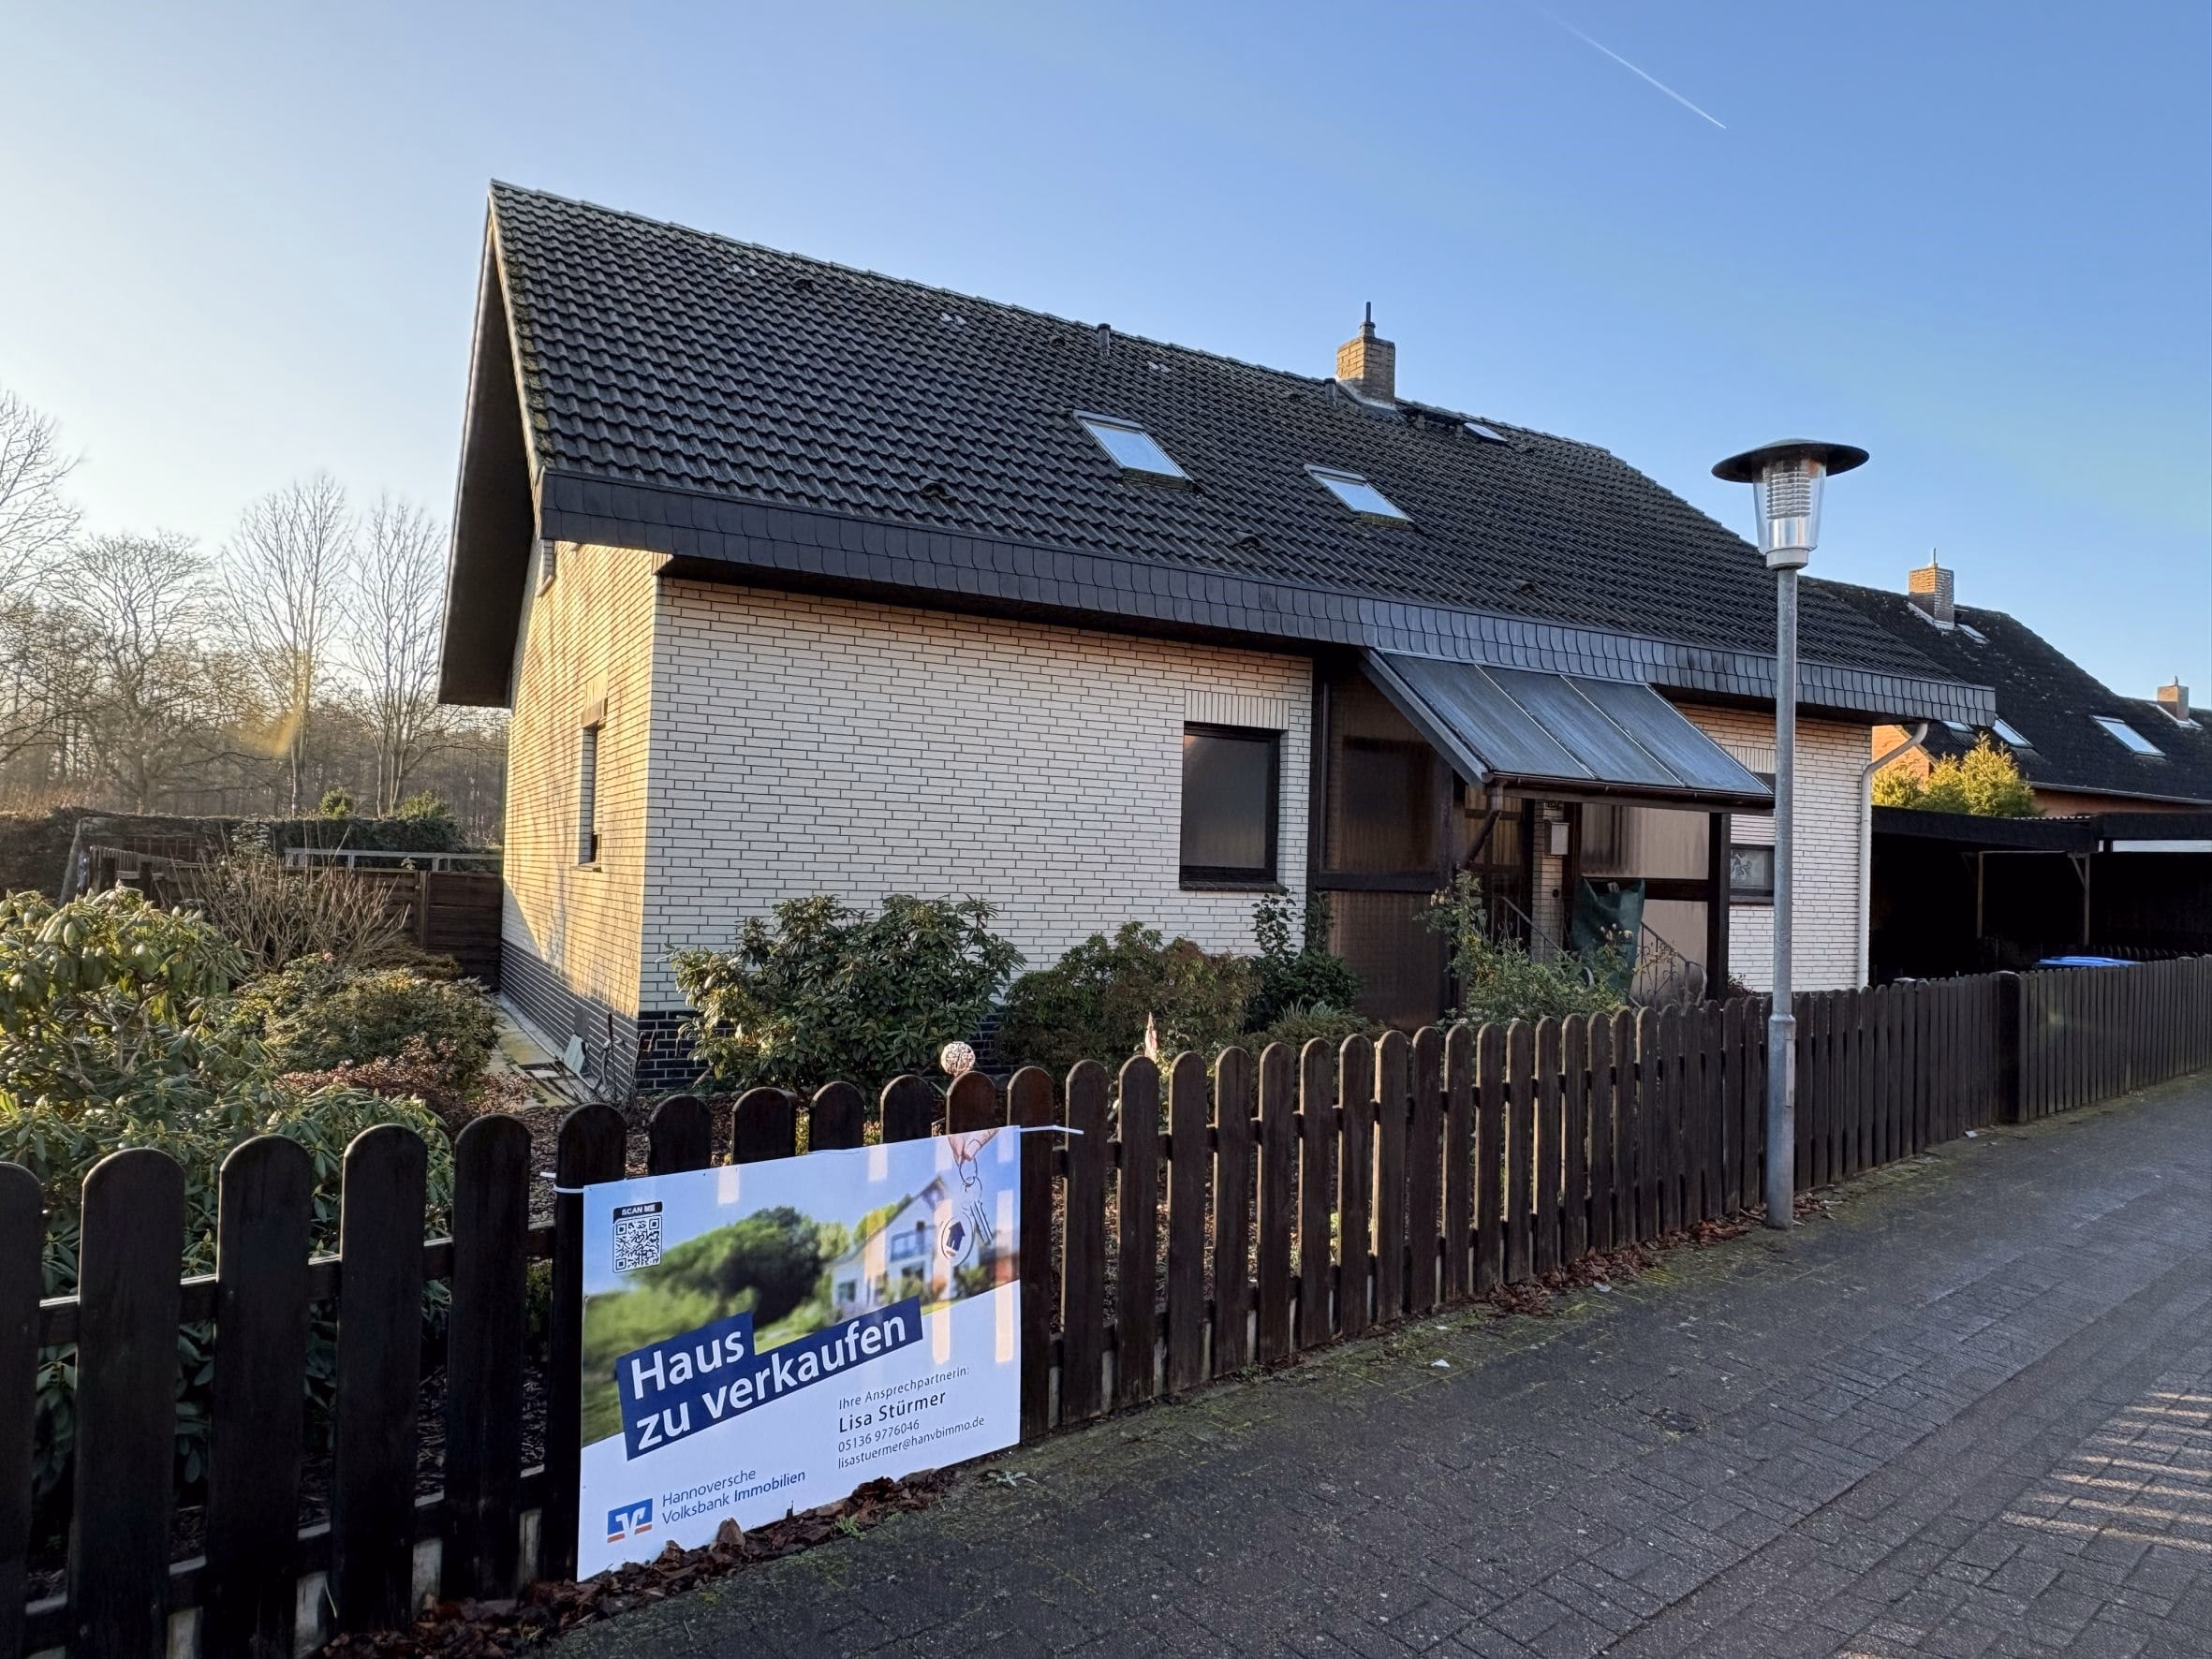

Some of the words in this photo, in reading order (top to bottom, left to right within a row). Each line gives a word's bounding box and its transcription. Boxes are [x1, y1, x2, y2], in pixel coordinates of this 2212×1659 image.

[630, 1329, 745, 1401] Haus
[636, 1402, 691, 1451] zu
[701, 1315, 906, 1420] verkaufen
[839, 1396, 862, 1410] Ihre
[865, 1367, 969, 1403] Ansprechpartnerin:
[838, 1433, 872, 1453] 05136
[875, 1418, 920, 1443] 9776046
[839, 1414, 872, 1433] Lisa
[878, 1391, 946, 1422] Stürmer
[838, 1416, 985, 1470] lisastuermer@hanvbimmo.de
[662, 1469, 757, 1507] Hannoversche
[662, 1492, 730, 1524] Volksbank
[734, 1471, 805, 1502] Immobilien
